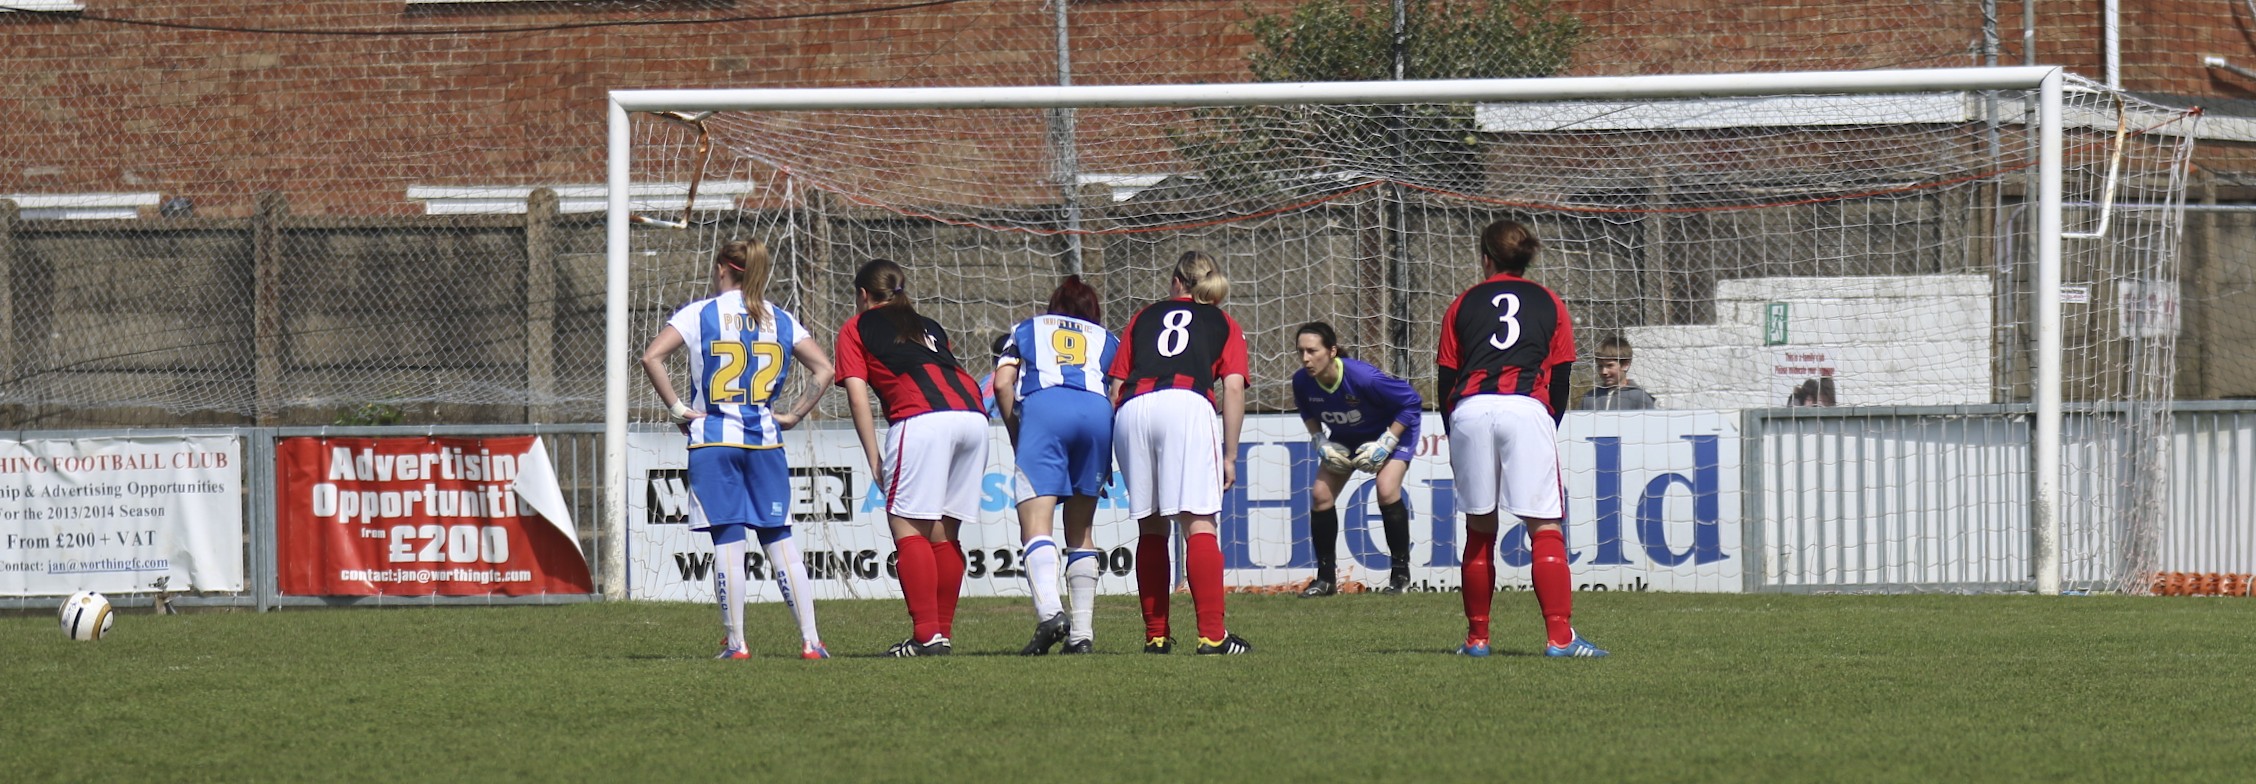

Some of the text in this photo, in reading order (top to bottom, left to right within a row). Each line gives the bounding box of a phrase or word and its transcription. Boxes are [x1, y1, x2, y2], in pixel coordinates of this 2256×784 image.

[1157, 309, 1193, 357] 8
[1489, 292, 1521, 350] 3
[1052, 328, 1087, 366] 9
[710, 340, 784, 405] 22
[51, 453, 167, 473] FOOTBALL
[172, 451, 229, 470] CLUB
[24, 484, 36, 498] &
[41, 482, 122, 499] Advertising
[127, 480, 226, 498] Opportunities
[23, 506, 43, 520] the
[47, 505, 115, 520] 2013/2014
[119, 504, 166, 518] Season
[7, 530, 157, 550] From £200 + VAT
[360, 524, 509, 563] from £200
[717, 572, 728, 611] BHAFC
[777, 570, 795, 607] BHAFC
